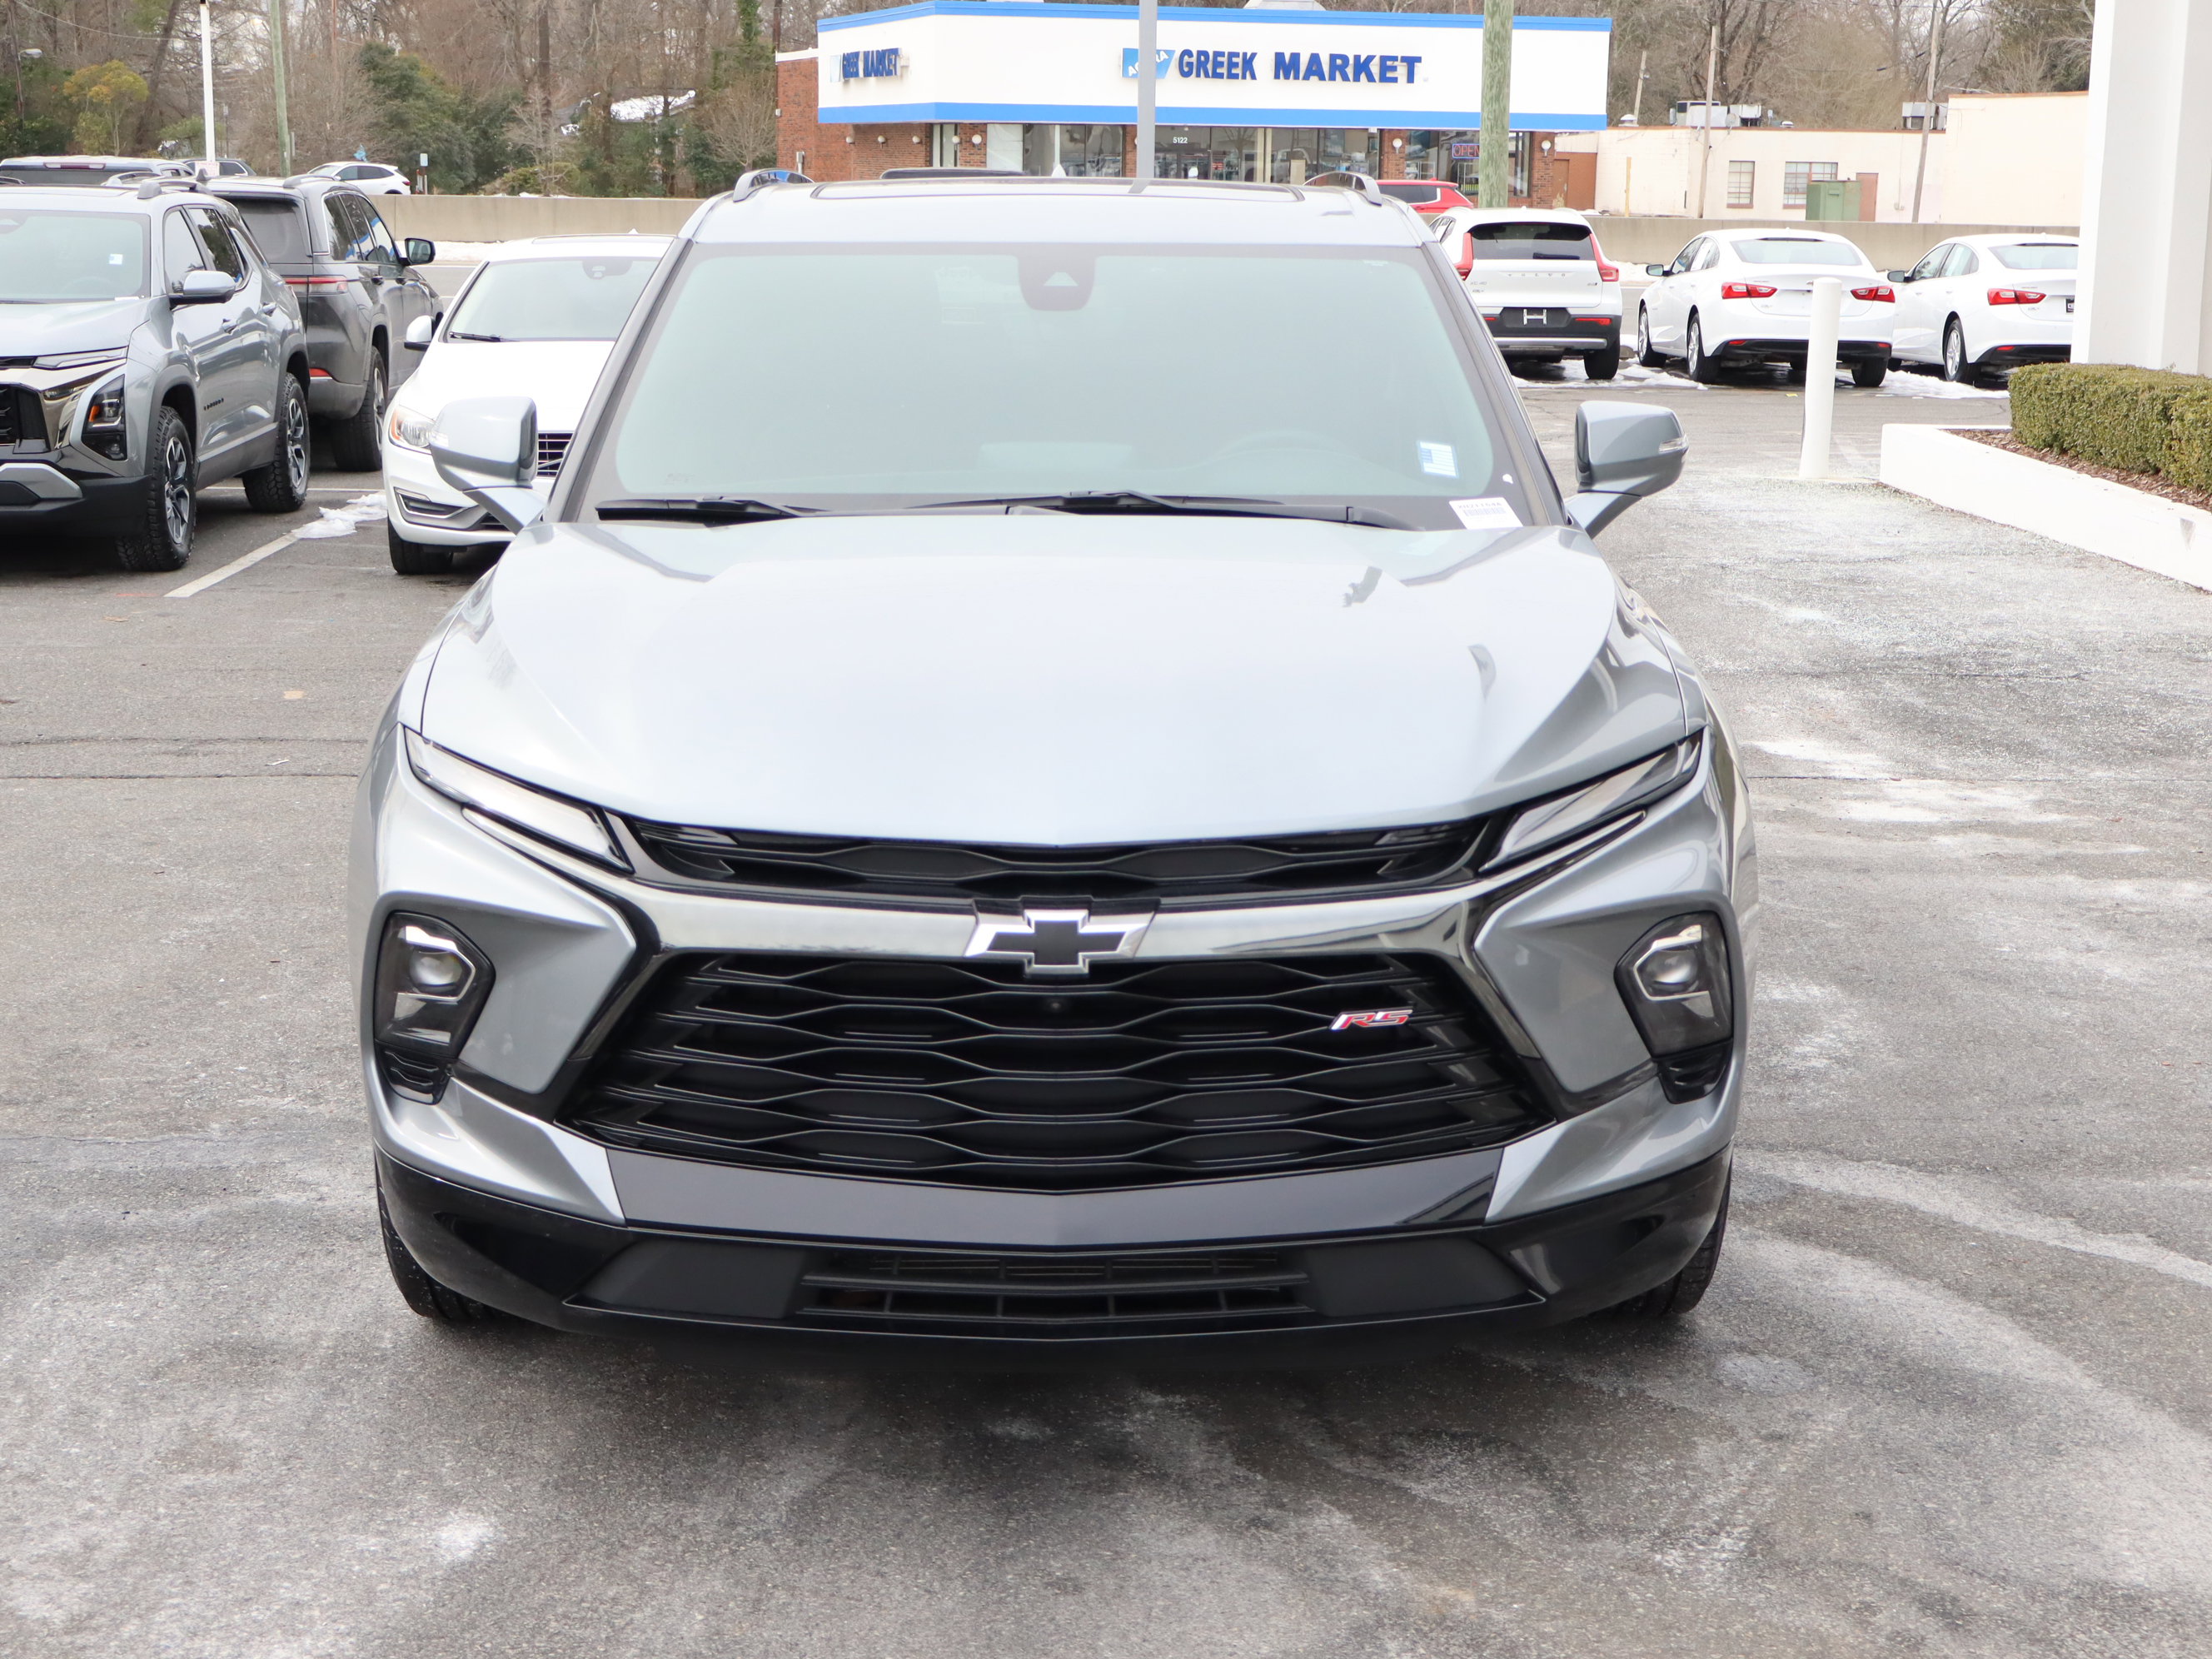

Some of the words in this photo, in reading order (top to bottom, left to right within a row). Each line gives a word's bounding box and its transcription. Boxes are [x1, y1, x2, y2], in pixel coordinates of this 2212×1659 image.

[863, 47, 899, 77] MARKET
[1128, 50, 1169, 77] ARA
[1178, 48, 1258, 80] GREEK
[1273, 52, 1422, 83] MARKET
[1453, 144, 1480, 157] OPEN
[1330, 1006, 1413, 1030] RS
